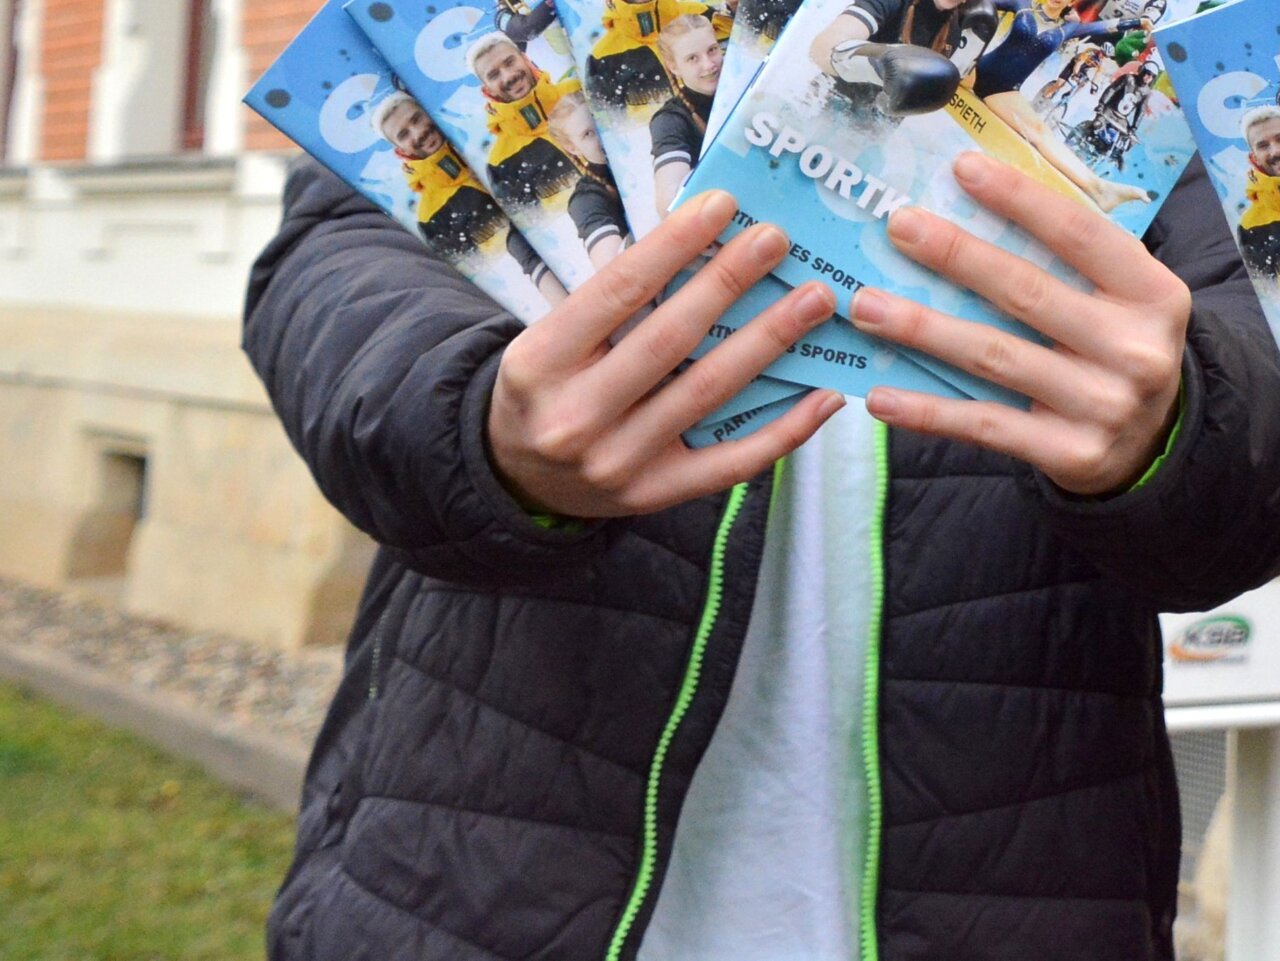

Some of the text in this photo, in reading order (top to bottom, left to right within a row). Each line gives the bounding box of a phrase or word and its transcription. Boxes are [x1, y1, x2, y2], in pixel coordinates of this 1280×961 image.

[949, 92, 987, 134] SPIETH
[744, 111, 912, 220] SPORTK
[811, 257, 865, 293] SPORT
[800, 343, 867, 370] SPORTS
